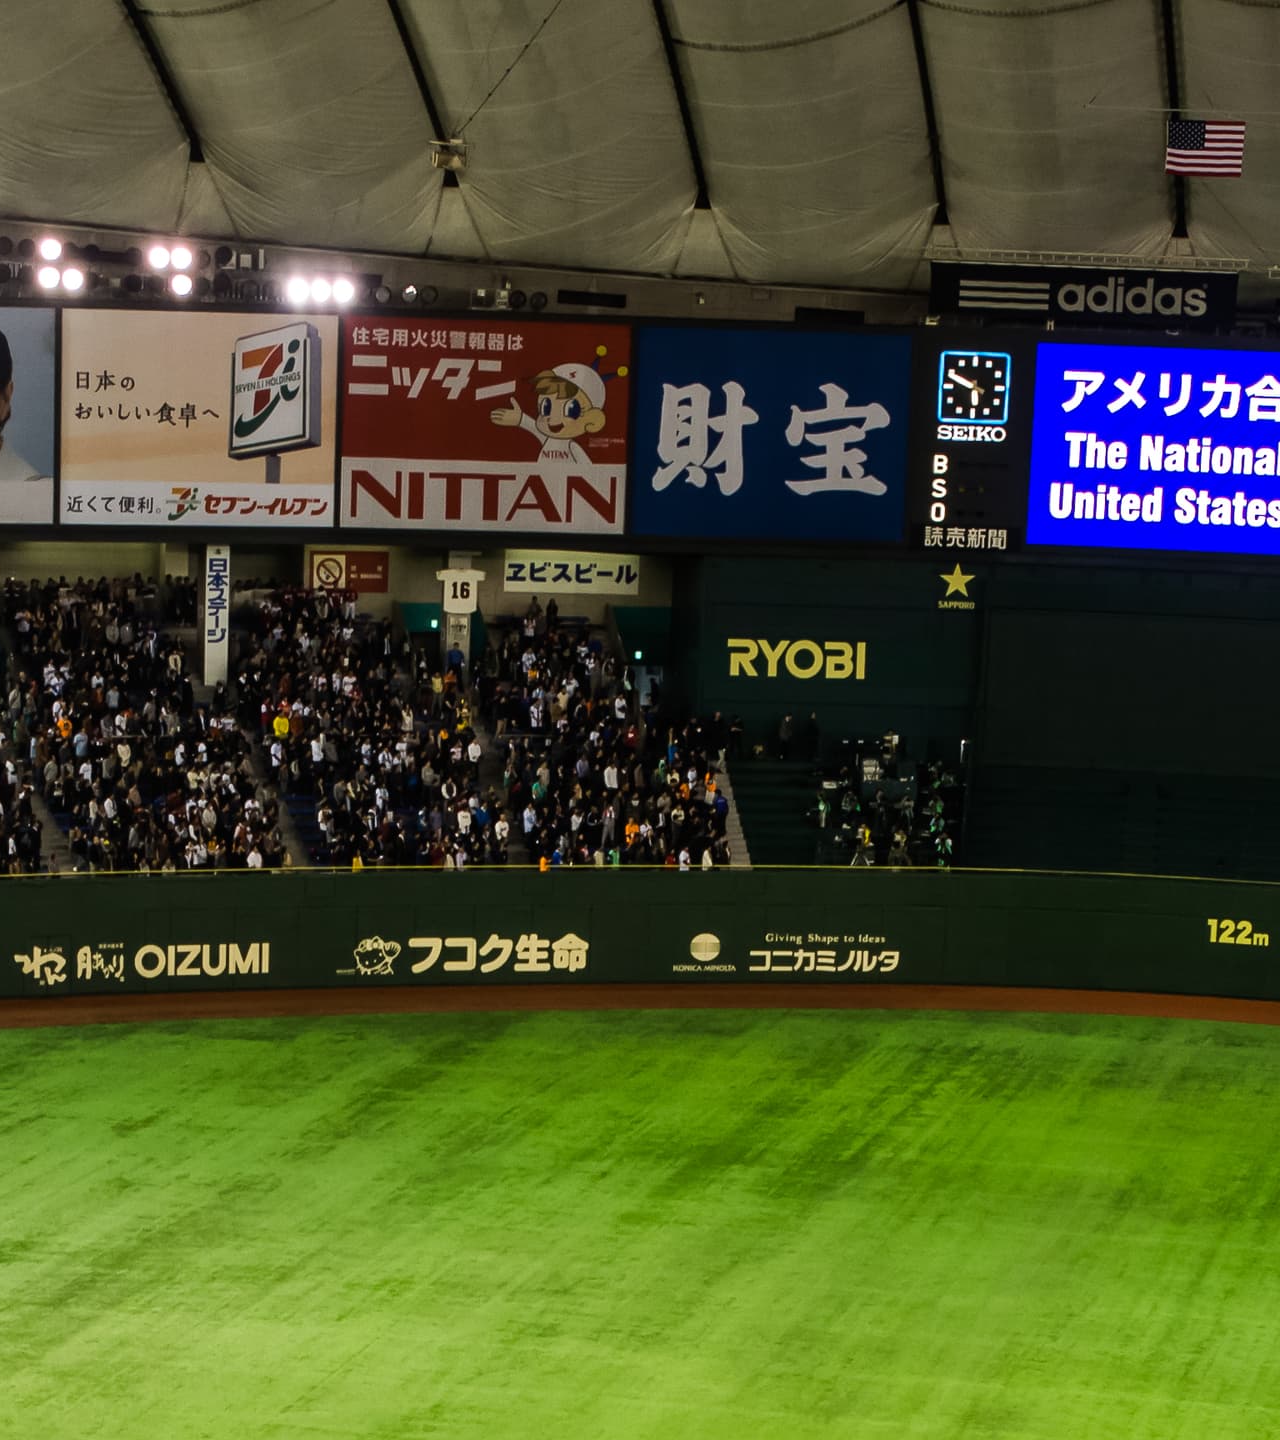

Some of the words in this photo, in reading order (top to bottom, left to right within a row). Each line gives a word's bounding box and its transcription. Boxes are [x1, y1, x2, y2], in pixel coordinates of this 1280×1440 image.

[1057, 276, 1207, 318] adidas
[352, 326, 524, 351] 住宅用火災警報器は
[74, 369, 137, 394] 日本の
[348, 354, 516, 400] ニッタン
[74, 401, 221, 429] おいしい食卓へ
[651, 380, 891, 496] 財宝
[937, 424, 1007, 442] SEIKO
[1064, 432, 1128, 469] The
[932, 454, 948, 475] B
[350, 469, 617, 524] NITTAN
[931, 478, 947, 499] S
[66, 495, 162, 515] 近くて便利。
[1048, 482, 1163, 524] United
[924, 526, 1008, 550] 読売新聞
[206, 558, 229, 644] 日本ステージ
[451, 581, 470, 600] 16
[938, 600, 976, 609] SAPPORO
[727, 638, 867, 681] RYOBI
[765, 932, 802, 944] Giving
[808, 933, 839, 943] Shape
[844, 934, 855, 943] to
[858, 933, 886, 943] Ideas
[1207, 918, 1270, 947] 122m
[134, 942, 270, 979] OIZUMI
[408, 933, 590, 974] フコク生命
[749, 949, 900, 972] コニカミノルタ
[673, 964, 702, 972] KONICA
[704, 964, 736, 972] MINOLTA
